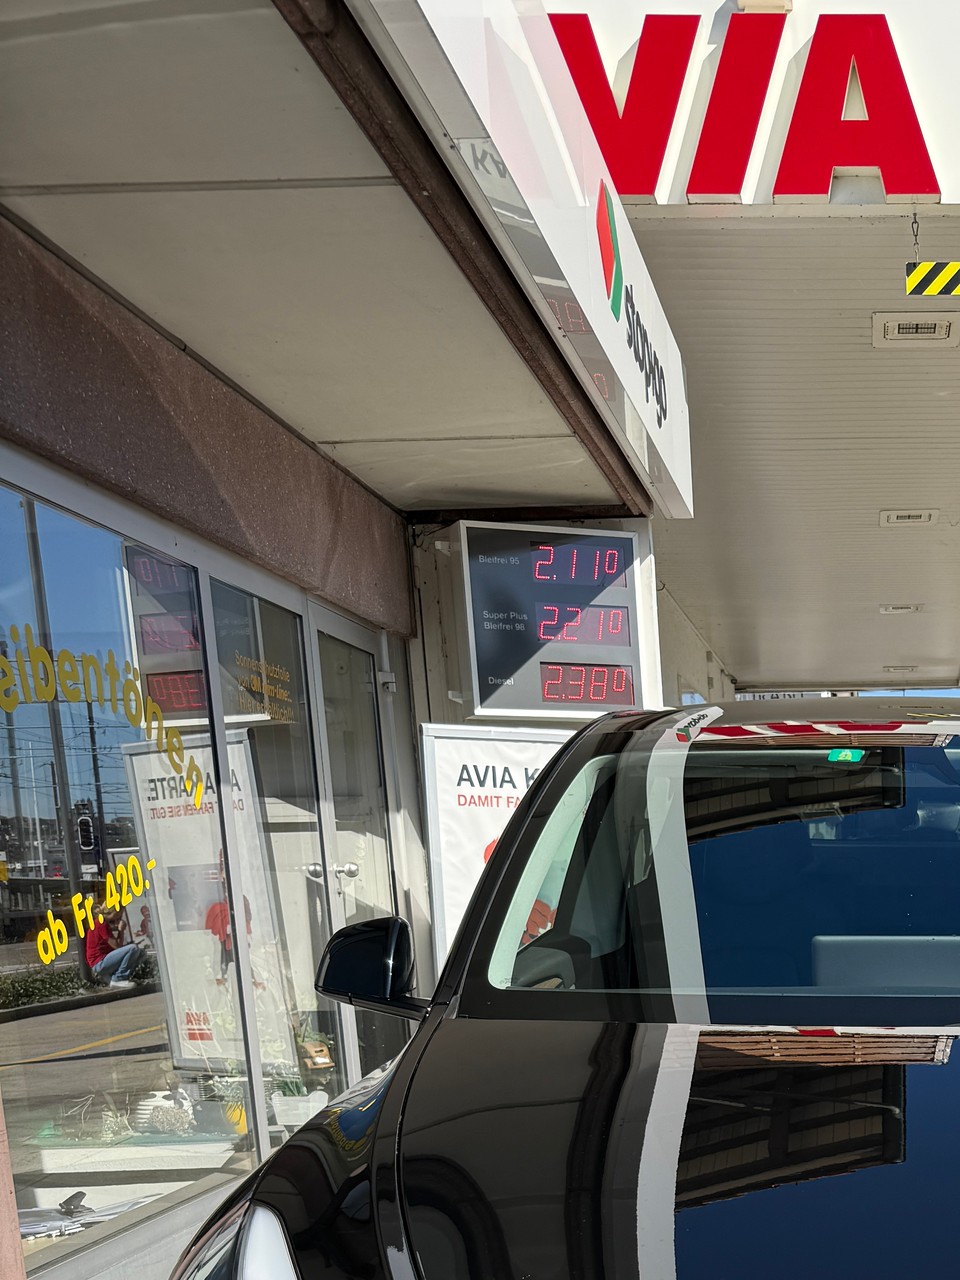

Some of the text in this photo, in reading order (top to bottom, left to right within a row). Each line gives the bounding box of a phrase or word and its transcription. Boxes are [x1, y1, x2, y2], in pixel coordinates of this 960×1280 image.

[478, 555, 508, 565] Bleifrei
[509, 557, 520, 565] 95
[483, 611, 528, 621] Super Plus
[484, 622, 514, 631] Bleifrei
[515, 623, 526, 631] 98
[488, 676, 514, 686] Diesel
[456, 764, 517, 790] AVIA
[457, 794, 503, 808] DAMIT
[37, 910, 69, 965] ab
[71, 892, 104, 939] Fr.
